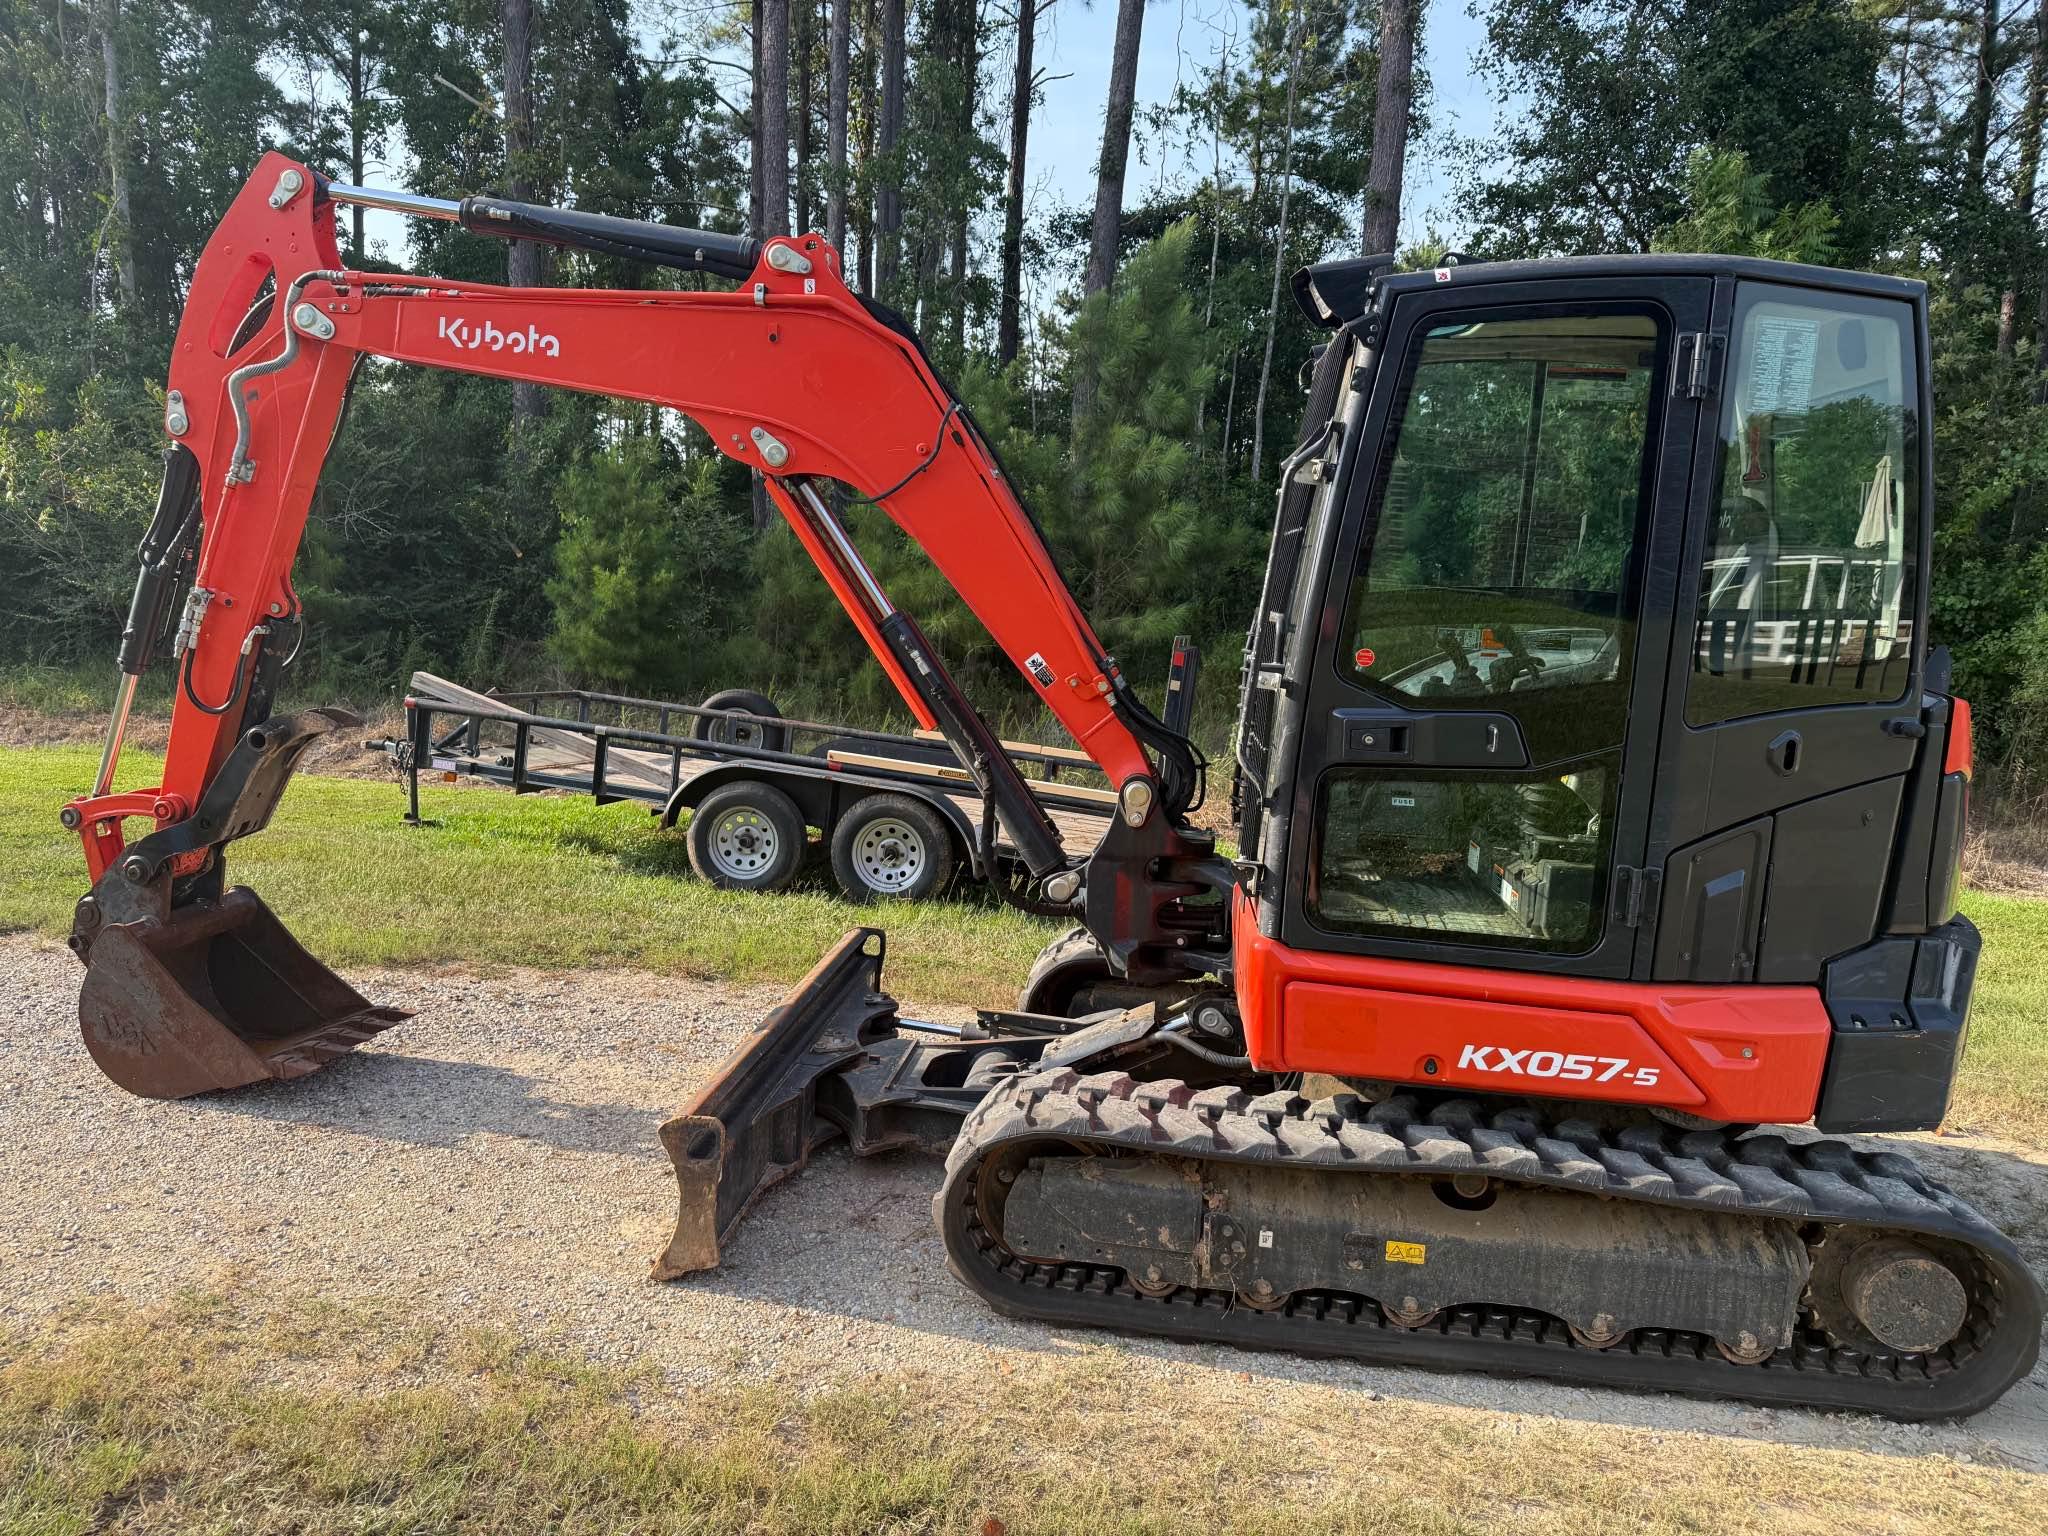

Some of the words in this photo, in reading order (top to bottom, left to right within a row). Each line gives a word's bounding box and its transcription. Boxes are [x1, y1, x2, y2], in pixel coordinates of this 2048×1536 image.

[438, 316, 560, 357] Kubota
[1393, 798, 1414, 806] FUSE
[1457, 1044, 1660, 1086] KX057-5
